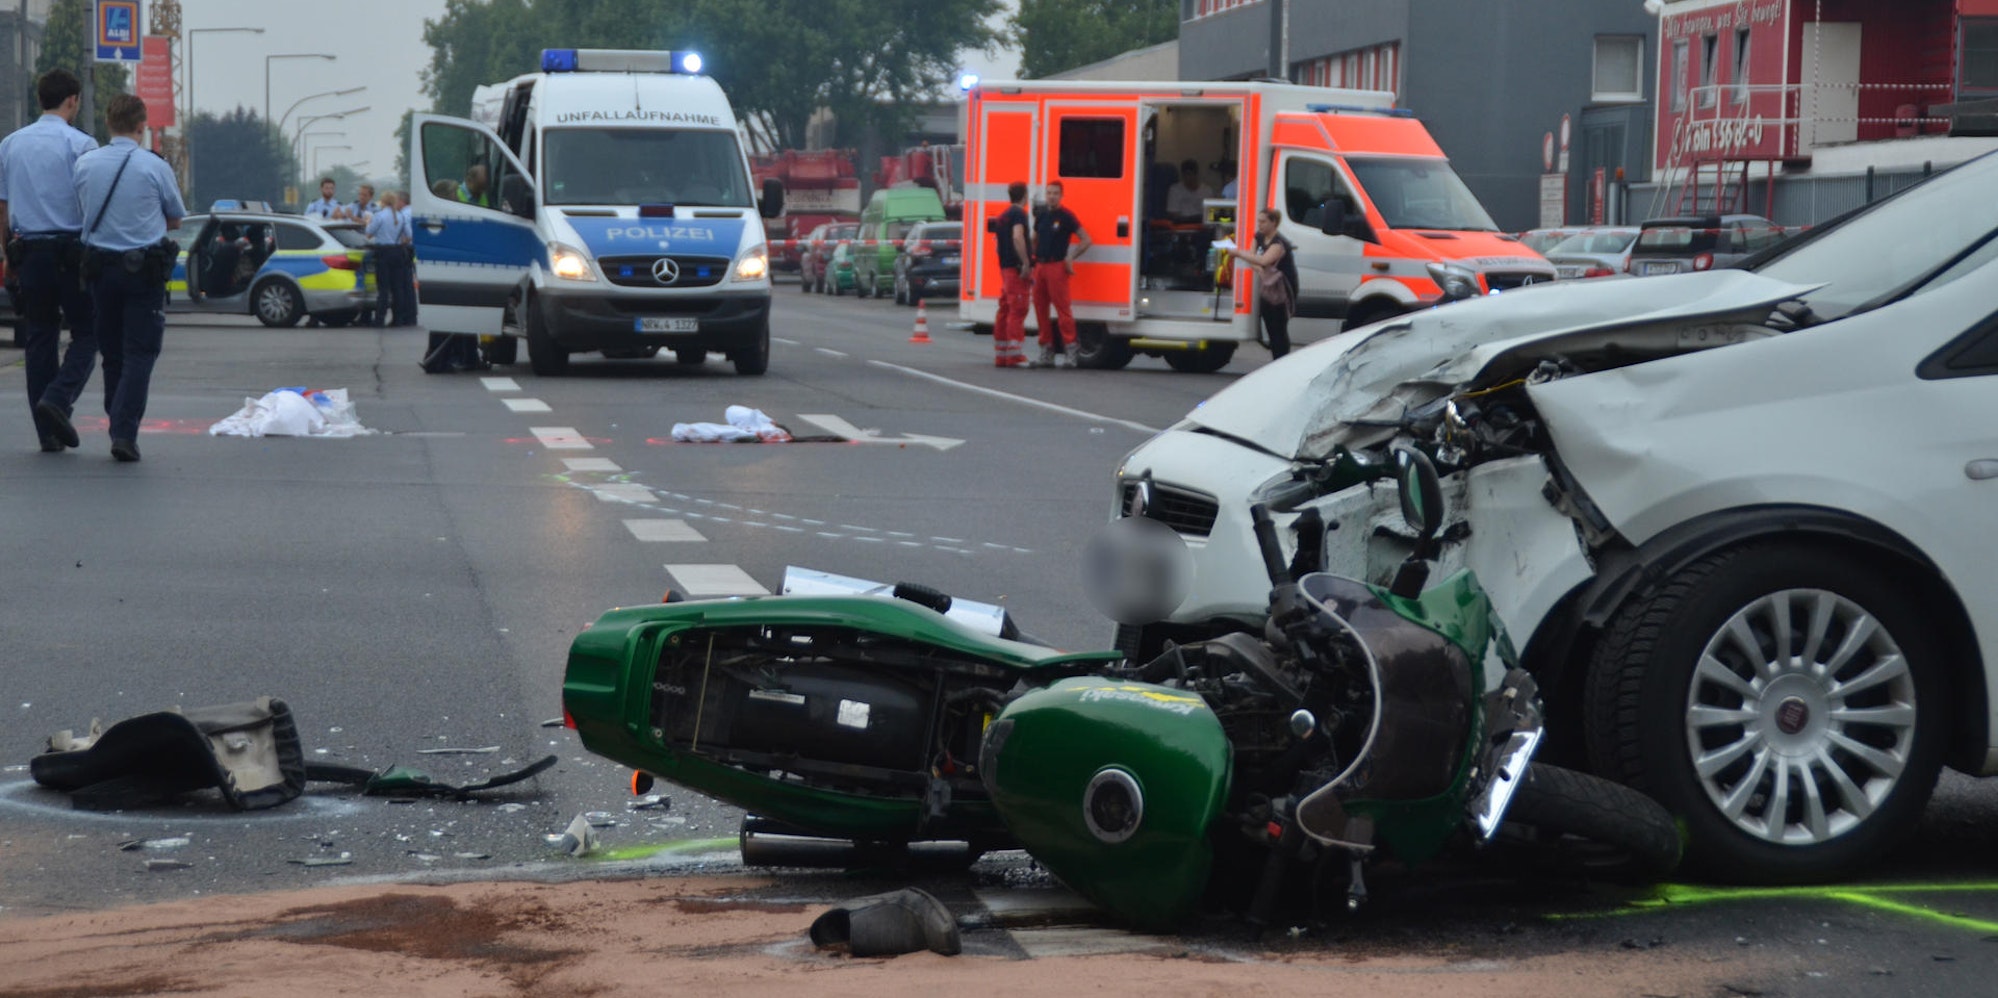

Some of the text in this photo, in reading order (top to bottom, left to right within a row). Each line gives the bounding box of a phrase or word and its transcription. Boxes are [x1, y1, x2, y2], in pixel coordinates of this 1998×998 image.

[107, 28, 130, 37] ALDI
[556, 110, 721, 127] UNFALLAUFNAHME
[606, 226, 714, 241] POLIZEI
